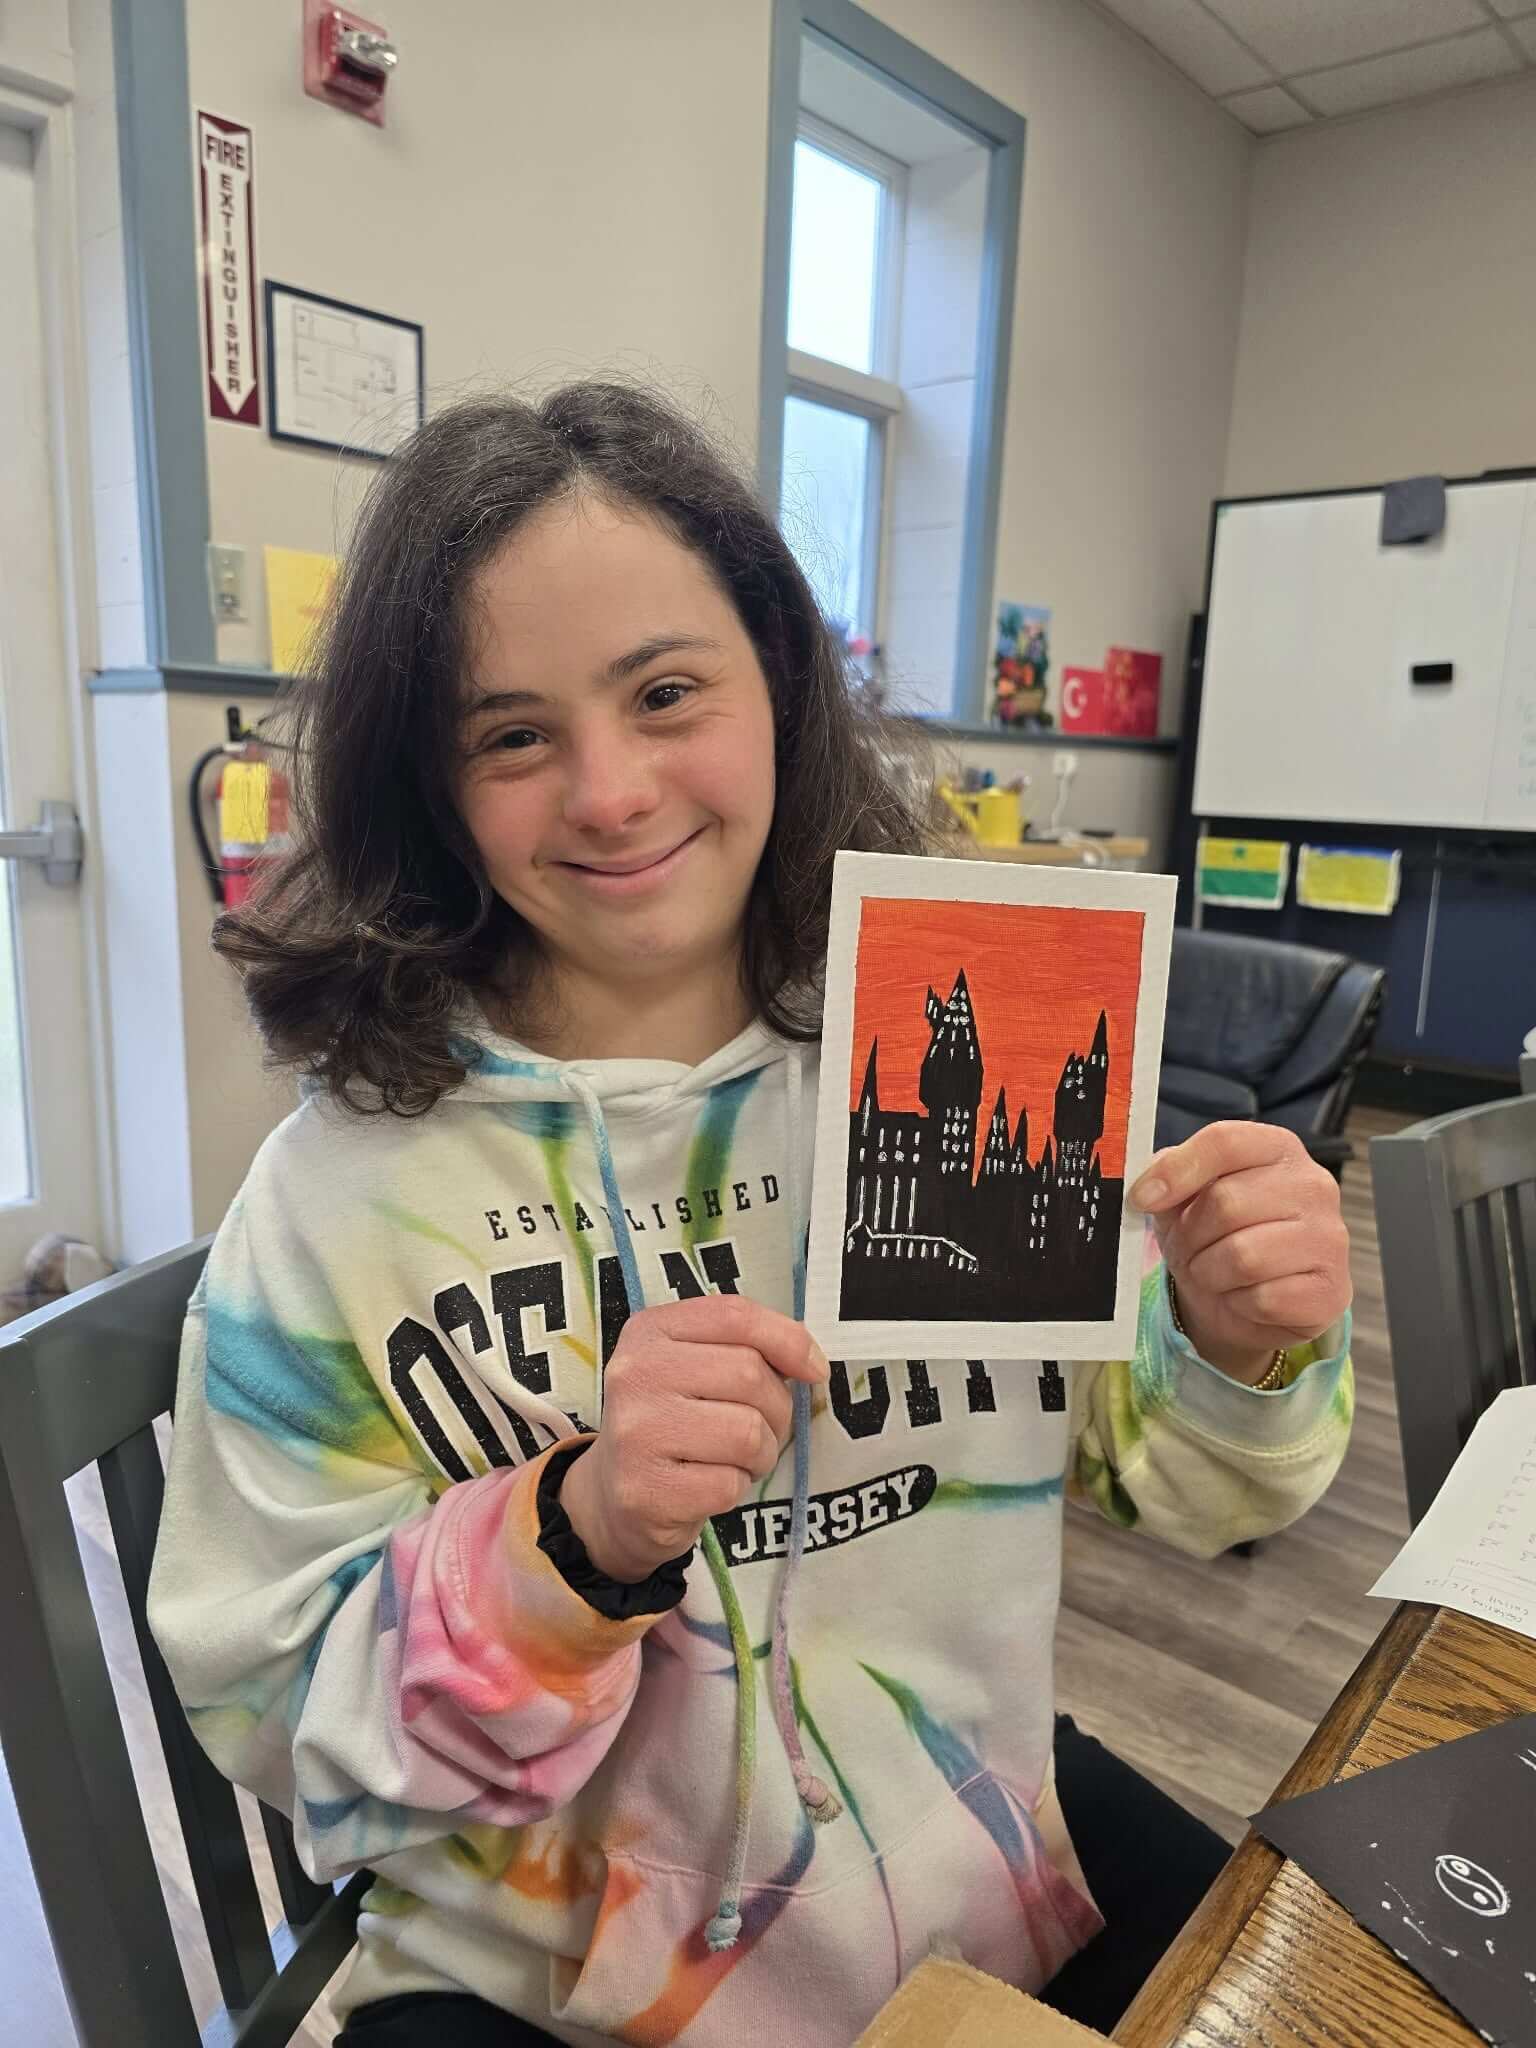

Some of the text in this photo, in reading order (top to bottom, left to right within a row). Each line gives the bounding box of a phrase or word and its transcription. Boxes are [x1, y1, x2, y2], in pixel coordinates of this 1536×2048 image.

[206, 134, 246, 171] FIRE
[219, 172, 242, 395] EXTINGUISHER
[484, 1174, 780, 1241] ESTALISHED
[731, 1469, 919, 1560] JERSEY
